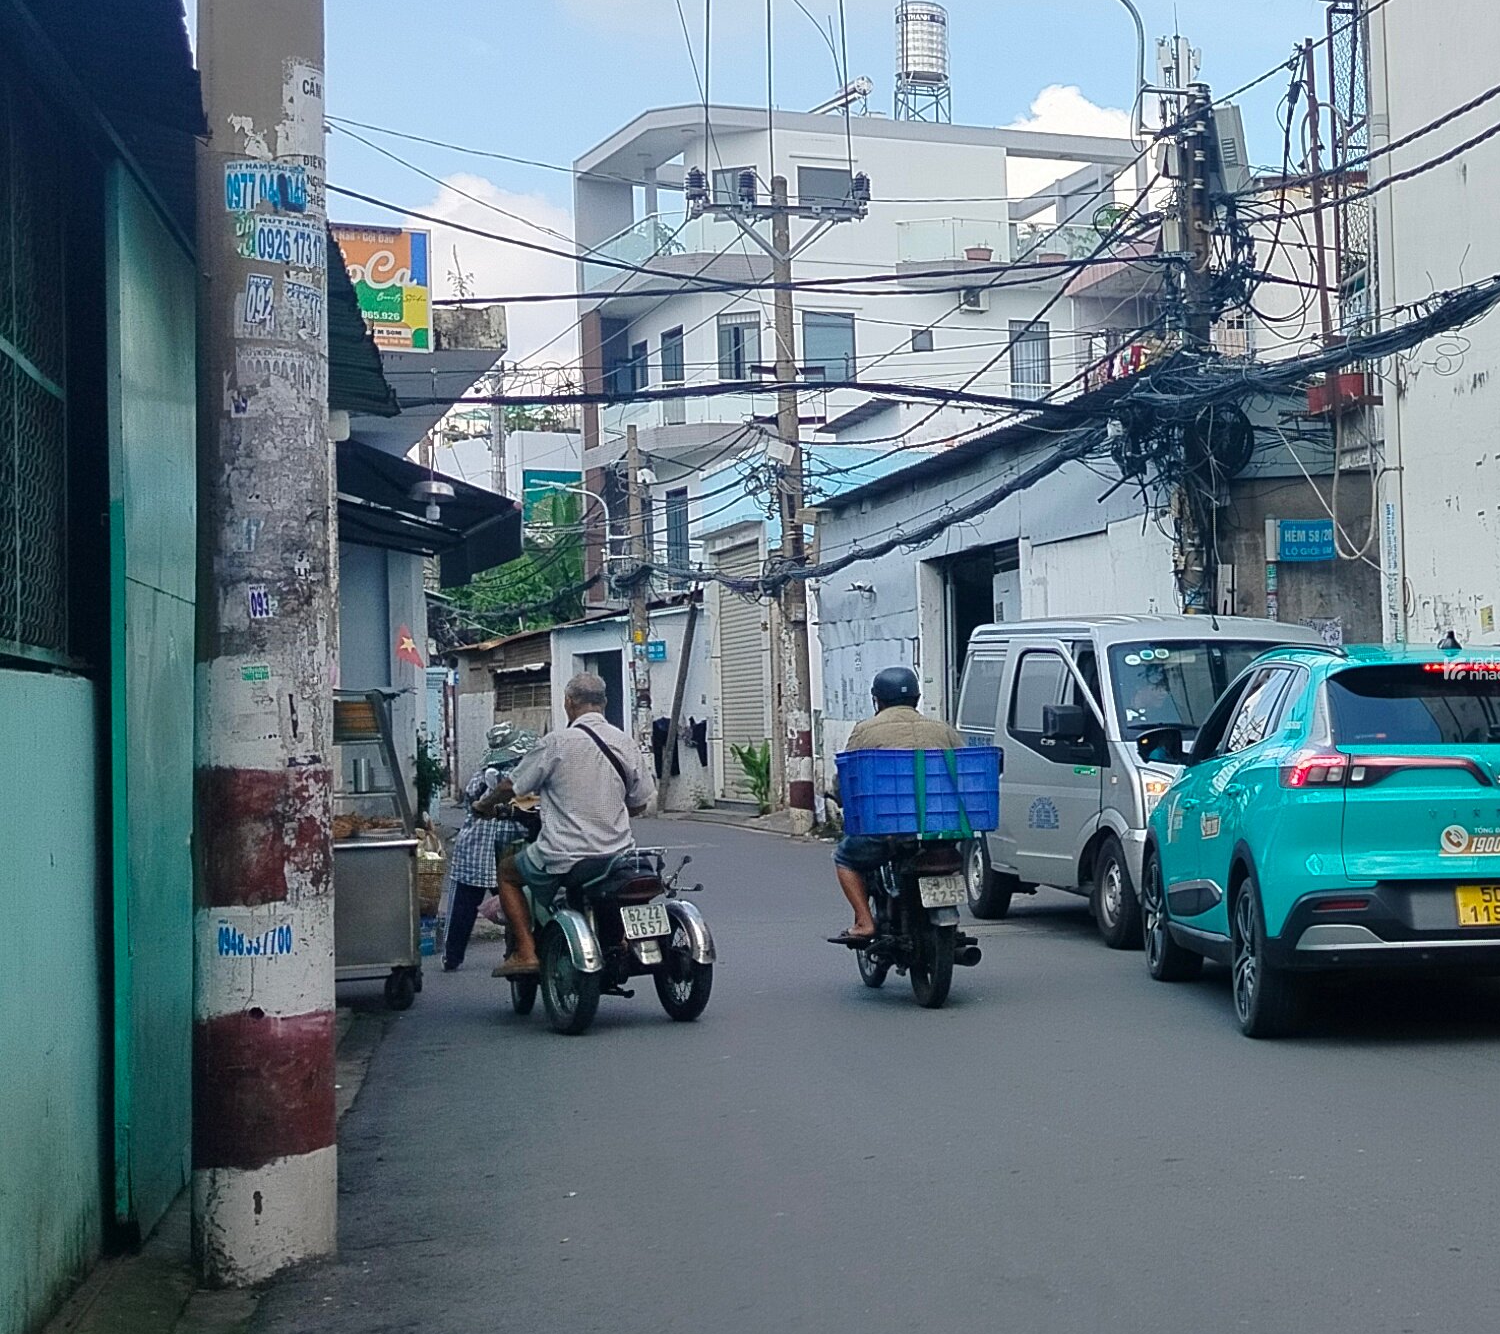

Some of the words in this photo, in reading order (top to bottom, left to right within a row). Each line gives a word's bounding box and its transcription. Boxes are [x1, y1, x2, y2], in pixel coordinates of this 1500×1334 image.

[226, 173, 255, 209] 0977
[258, 227, 291, 260] 0926
[632, 921, 663, 936] 0657
